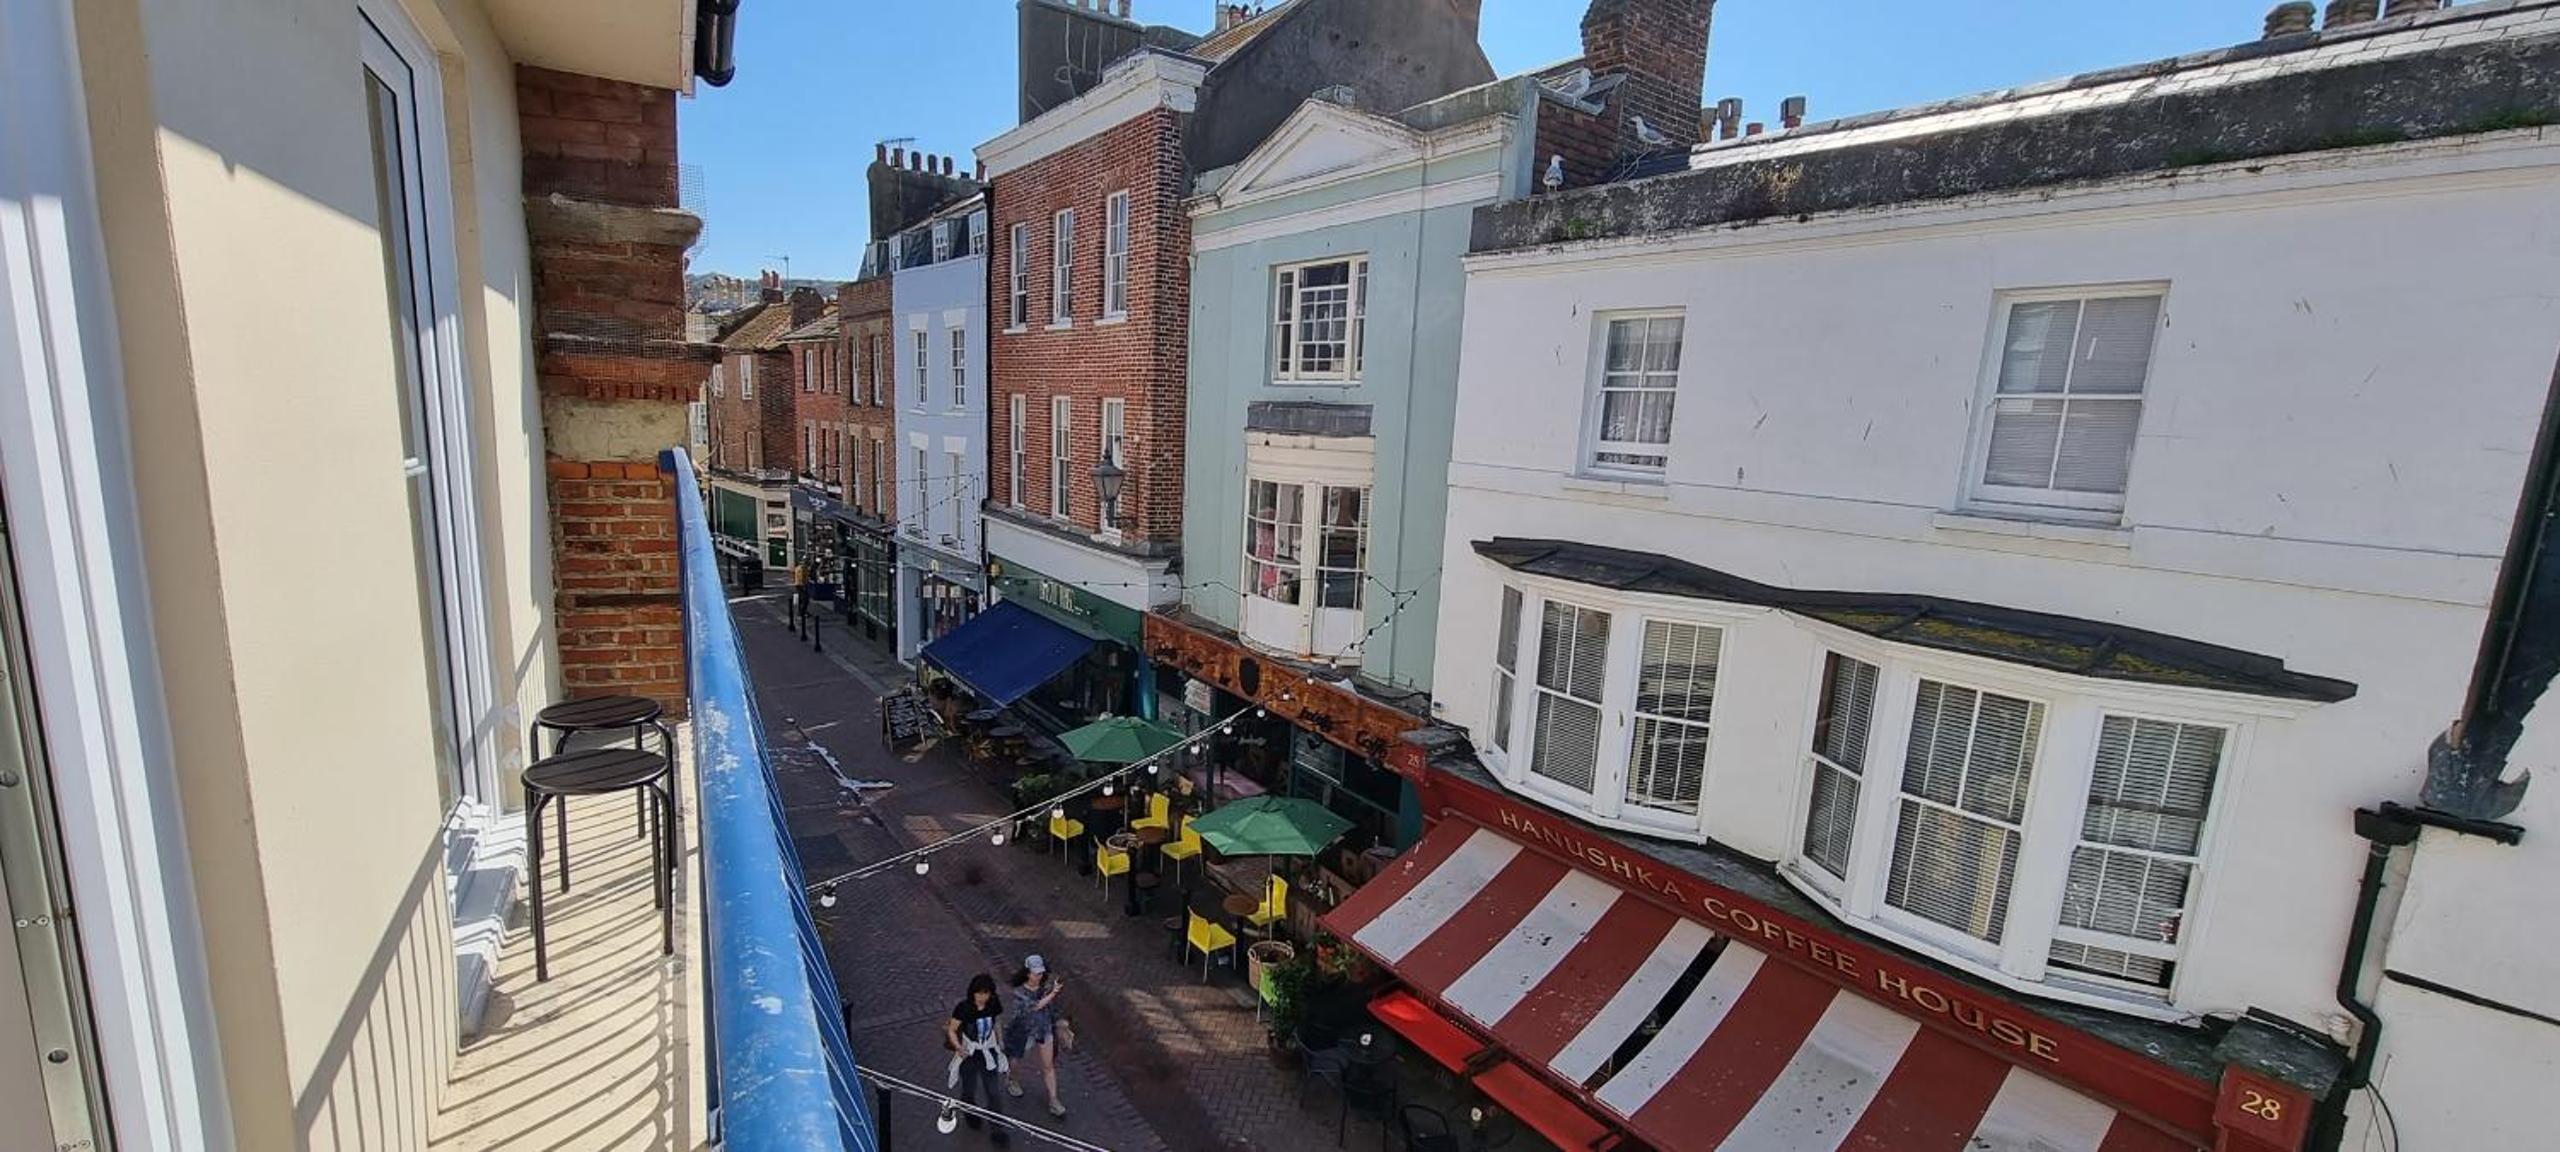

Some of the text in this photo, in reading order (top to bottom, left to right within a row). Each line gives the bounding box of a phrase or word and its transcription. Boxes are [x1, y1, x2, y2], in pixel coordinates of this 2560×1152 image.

[1500, 809, 2060, 1062] HANUSHKA COFFEE HOUSE
[2240, 1090, 2281, 1120] 28
